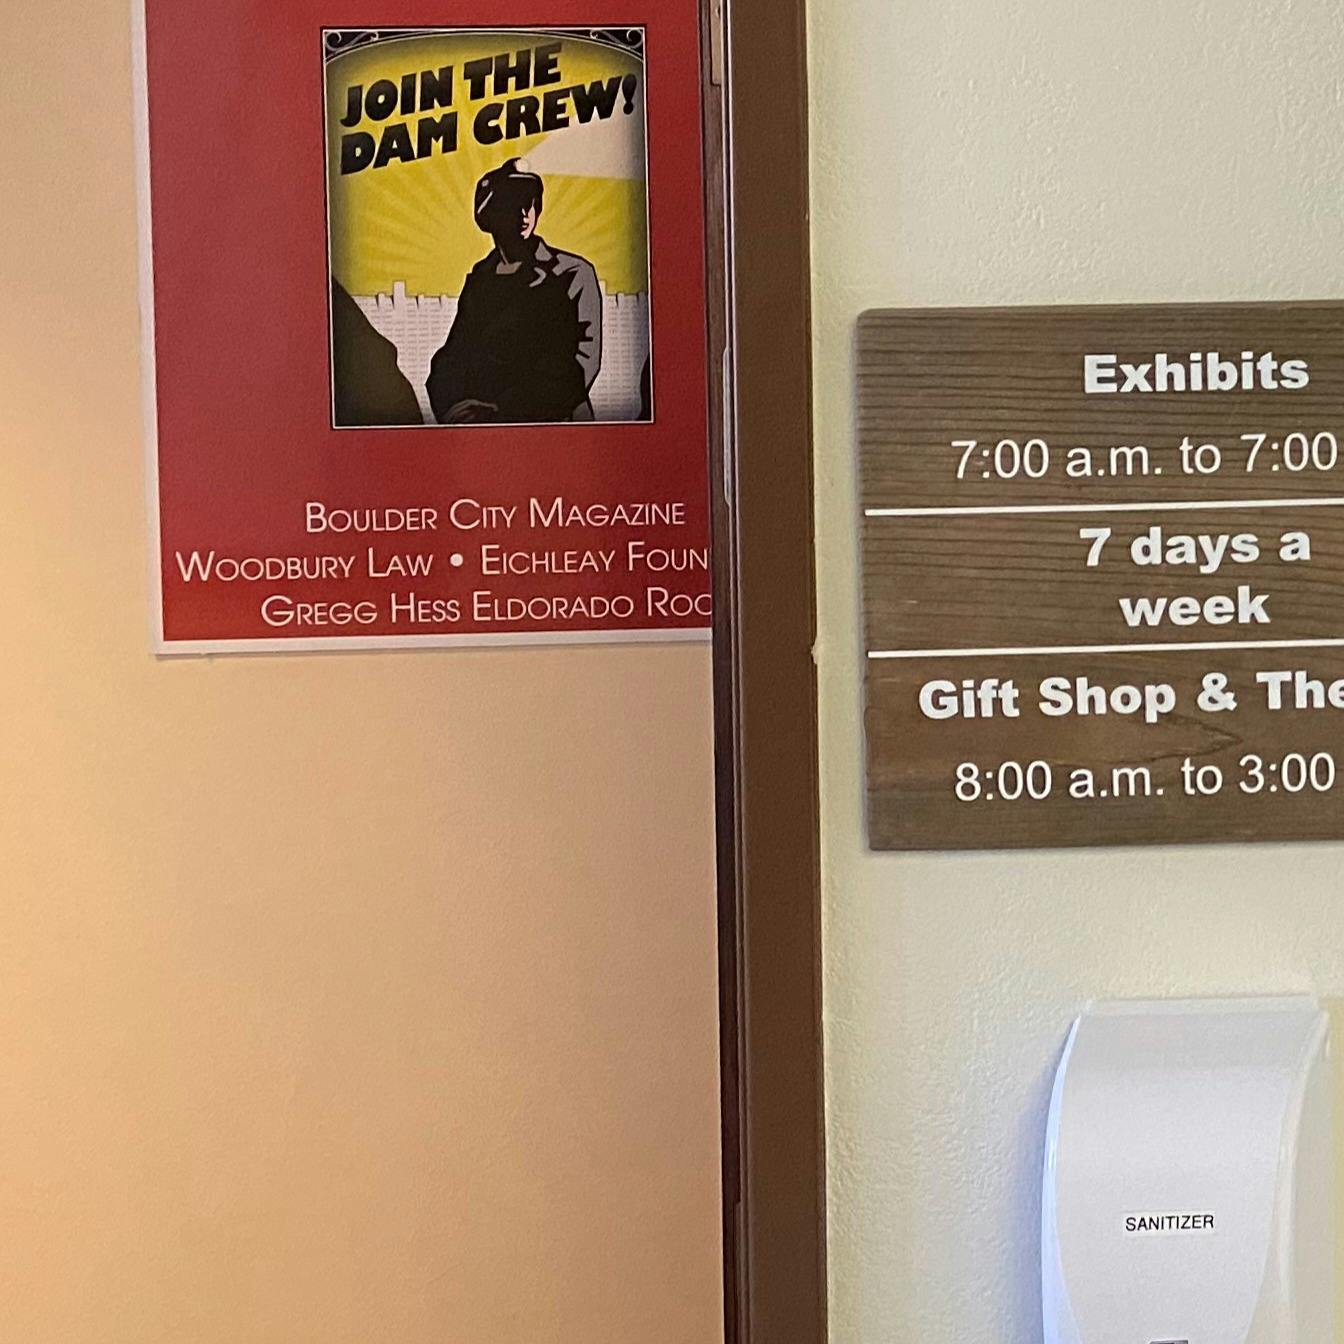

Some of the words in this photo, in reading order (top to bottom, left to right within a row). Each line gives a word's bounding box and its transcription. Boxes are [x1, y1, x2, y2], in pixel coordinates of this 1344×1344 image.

[340, 65, 454, 128] JOIN
[463, 42, 562, 102] THE
[341, 111, 458, 176] DAM
[473, 73, 638, 146] CREW!
[1083, 351, 1311, 395] Exhibits
[950, 438, 1050, 480] 7:00
[1065, 444, 1163, 478] a.m.
[1179, 436, 1222, 474] to
[1239, 431, 1339, 473] 7:00
[305, 501, 438, 534] BOULDER
[449, 498, 517, 531] CITY
[529, 496, 686, 529] MAGAZINE
[175, 550, 355, 583] WOODBURY
[367, 546, 435, 578] LAW
[480, 543, 616, 576] EICHLEAY
[1079, 527, 1112, 567] 7
[1130, 525, 1262, 573] days
[1278, 529, 1312, 562] a
[260, 594, 378, 627] GREGG
[390, 591, 461, 624] HESS
[472, 590, 634, 623] ELDORADO
[1119, 584, 1272, 628] week
[918, 678, 1020, 720] Gift
[1038, 675, 1177, 723] Shop
[1197, 671, 1238, 713] &
[954, 761, 1053, 802] 8:00
[1068, 765, 1164, 798] a.m.
[1181, 756, 1223, 796] to
[1238, 752, 1335, 794] 3:00
[1125, 1214, 1215, 1233] SANITIZER
